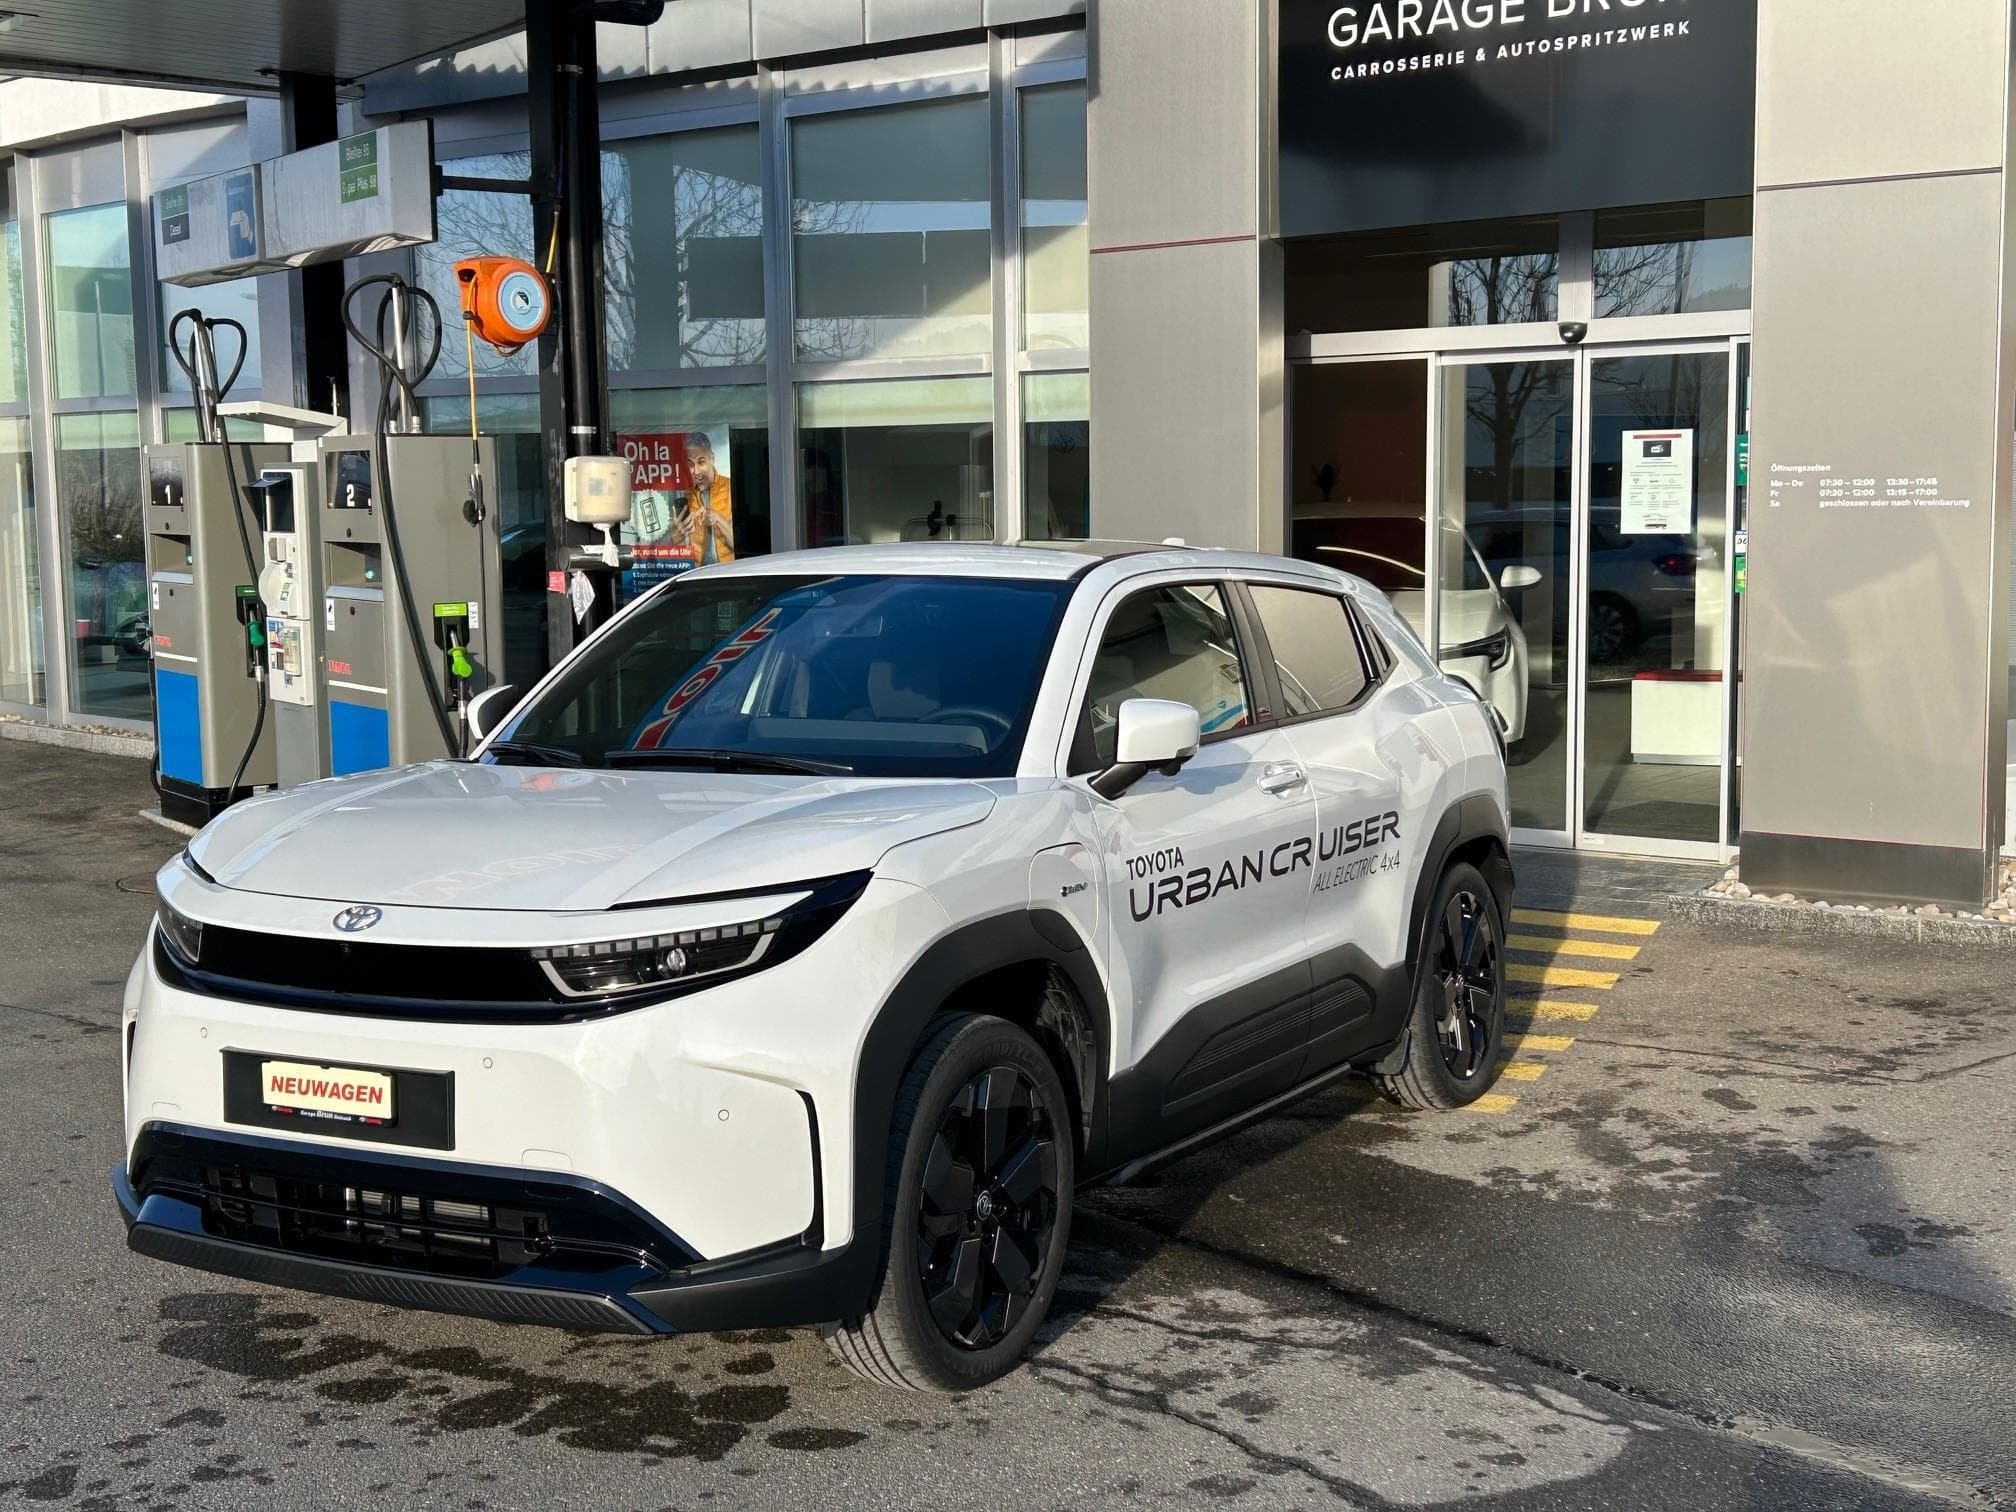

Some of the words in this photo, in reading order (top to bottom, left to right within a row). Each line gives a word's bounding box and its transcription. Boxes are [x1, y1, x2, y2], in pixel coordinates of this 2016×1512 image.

[1327, 0, 1526, 48] GARAGE
[1331, 51, 1465, 81] CARROSSERIE
[1475, 48, 1486, 62] &
[1496, 20, 1691, 59] AUTOSPRITZWERK
[624, 441, 649, 462] Oh
[654, 441, 670, 461] la
[1770, 463, 1831, 474] Öffnungszeiten
[1819, 478, 1843, 487] 07:30
[1852, 478, 1875, 487] 12:00
[1852, 488, 1875, 497] 12:00
[164, 484, 171, 505] 1
[346, 484, 355, 507] 2
[1819, 499, 1868, 509] geschlossen
[1871, 499, 1889, 508] oder
[1891, 498, 1911, 507] nach
[1913, 498, 1970, 509] Vereinbarung
[1125, 846, 1185, 881] TOYOTA
[1129, 849, 1264, 923] URBAN
[1269, 810, 1402, 877] CRUISER
[1312, 872, 1332, 895] ALL
[1332, 854, 1379, 888] ELECTRIC
[1380, 849, 1401, 873] 4x4
[270, 1075, 384, 1105] NEUWAGEN
[316, 1110, 334, 1120] Brun
